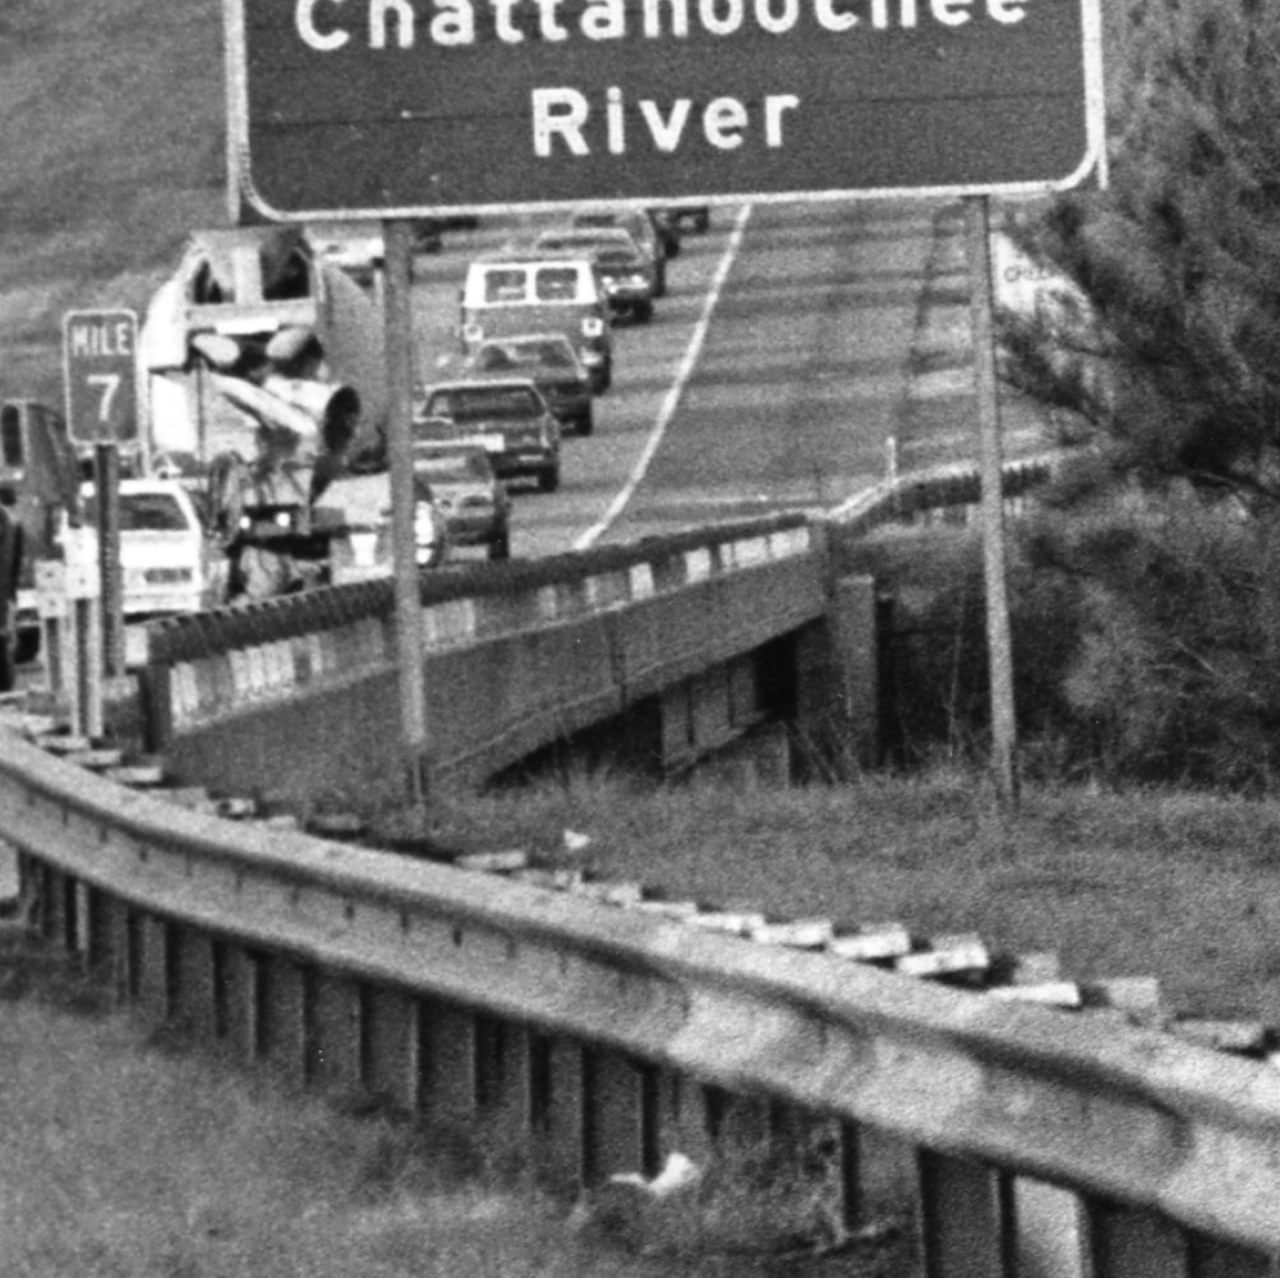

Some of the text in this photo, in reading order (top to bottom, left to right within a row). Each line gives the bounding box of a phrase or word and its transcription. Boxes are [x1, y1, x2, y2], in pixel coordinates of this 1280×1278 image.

[531, 85, 801, 157] River
[72, 323, 130, 356] MILE
[86, 373, 120, 421] 7
